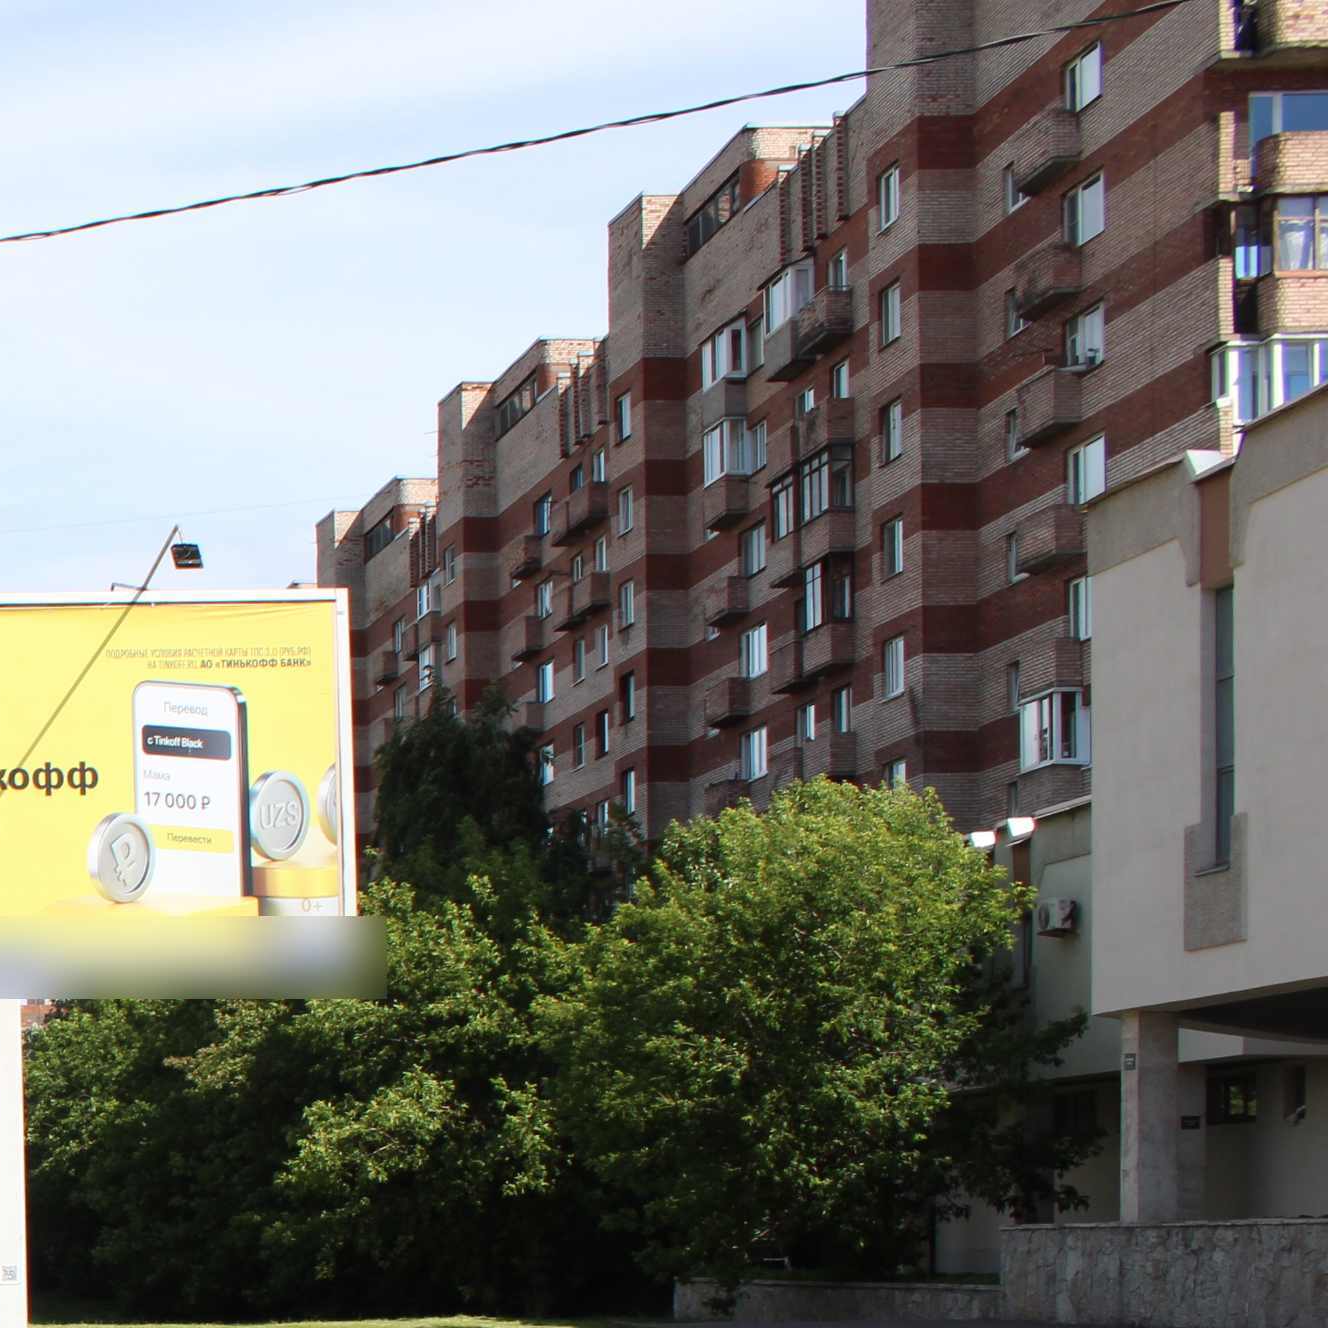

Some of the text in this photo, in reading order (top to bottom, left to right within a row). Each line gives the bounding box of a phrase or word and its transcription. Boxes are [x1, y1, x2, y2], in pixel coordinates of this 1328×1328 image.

[200, 659, 213, 669] АО
[280, 658, 312, 668] БАНК»
[163, 701, 208, 716] Перевод
[154, 735, 181, 747] Tinkoff
[181, 737, 203, 749] Black
[144, 791, 162, 808] 17
[164, 793, 197, 810] 000
[259, 800, 301, 830] UZS
[167, 832, 212, 845] Перевести
[301, 898, 324, 913] 0+
